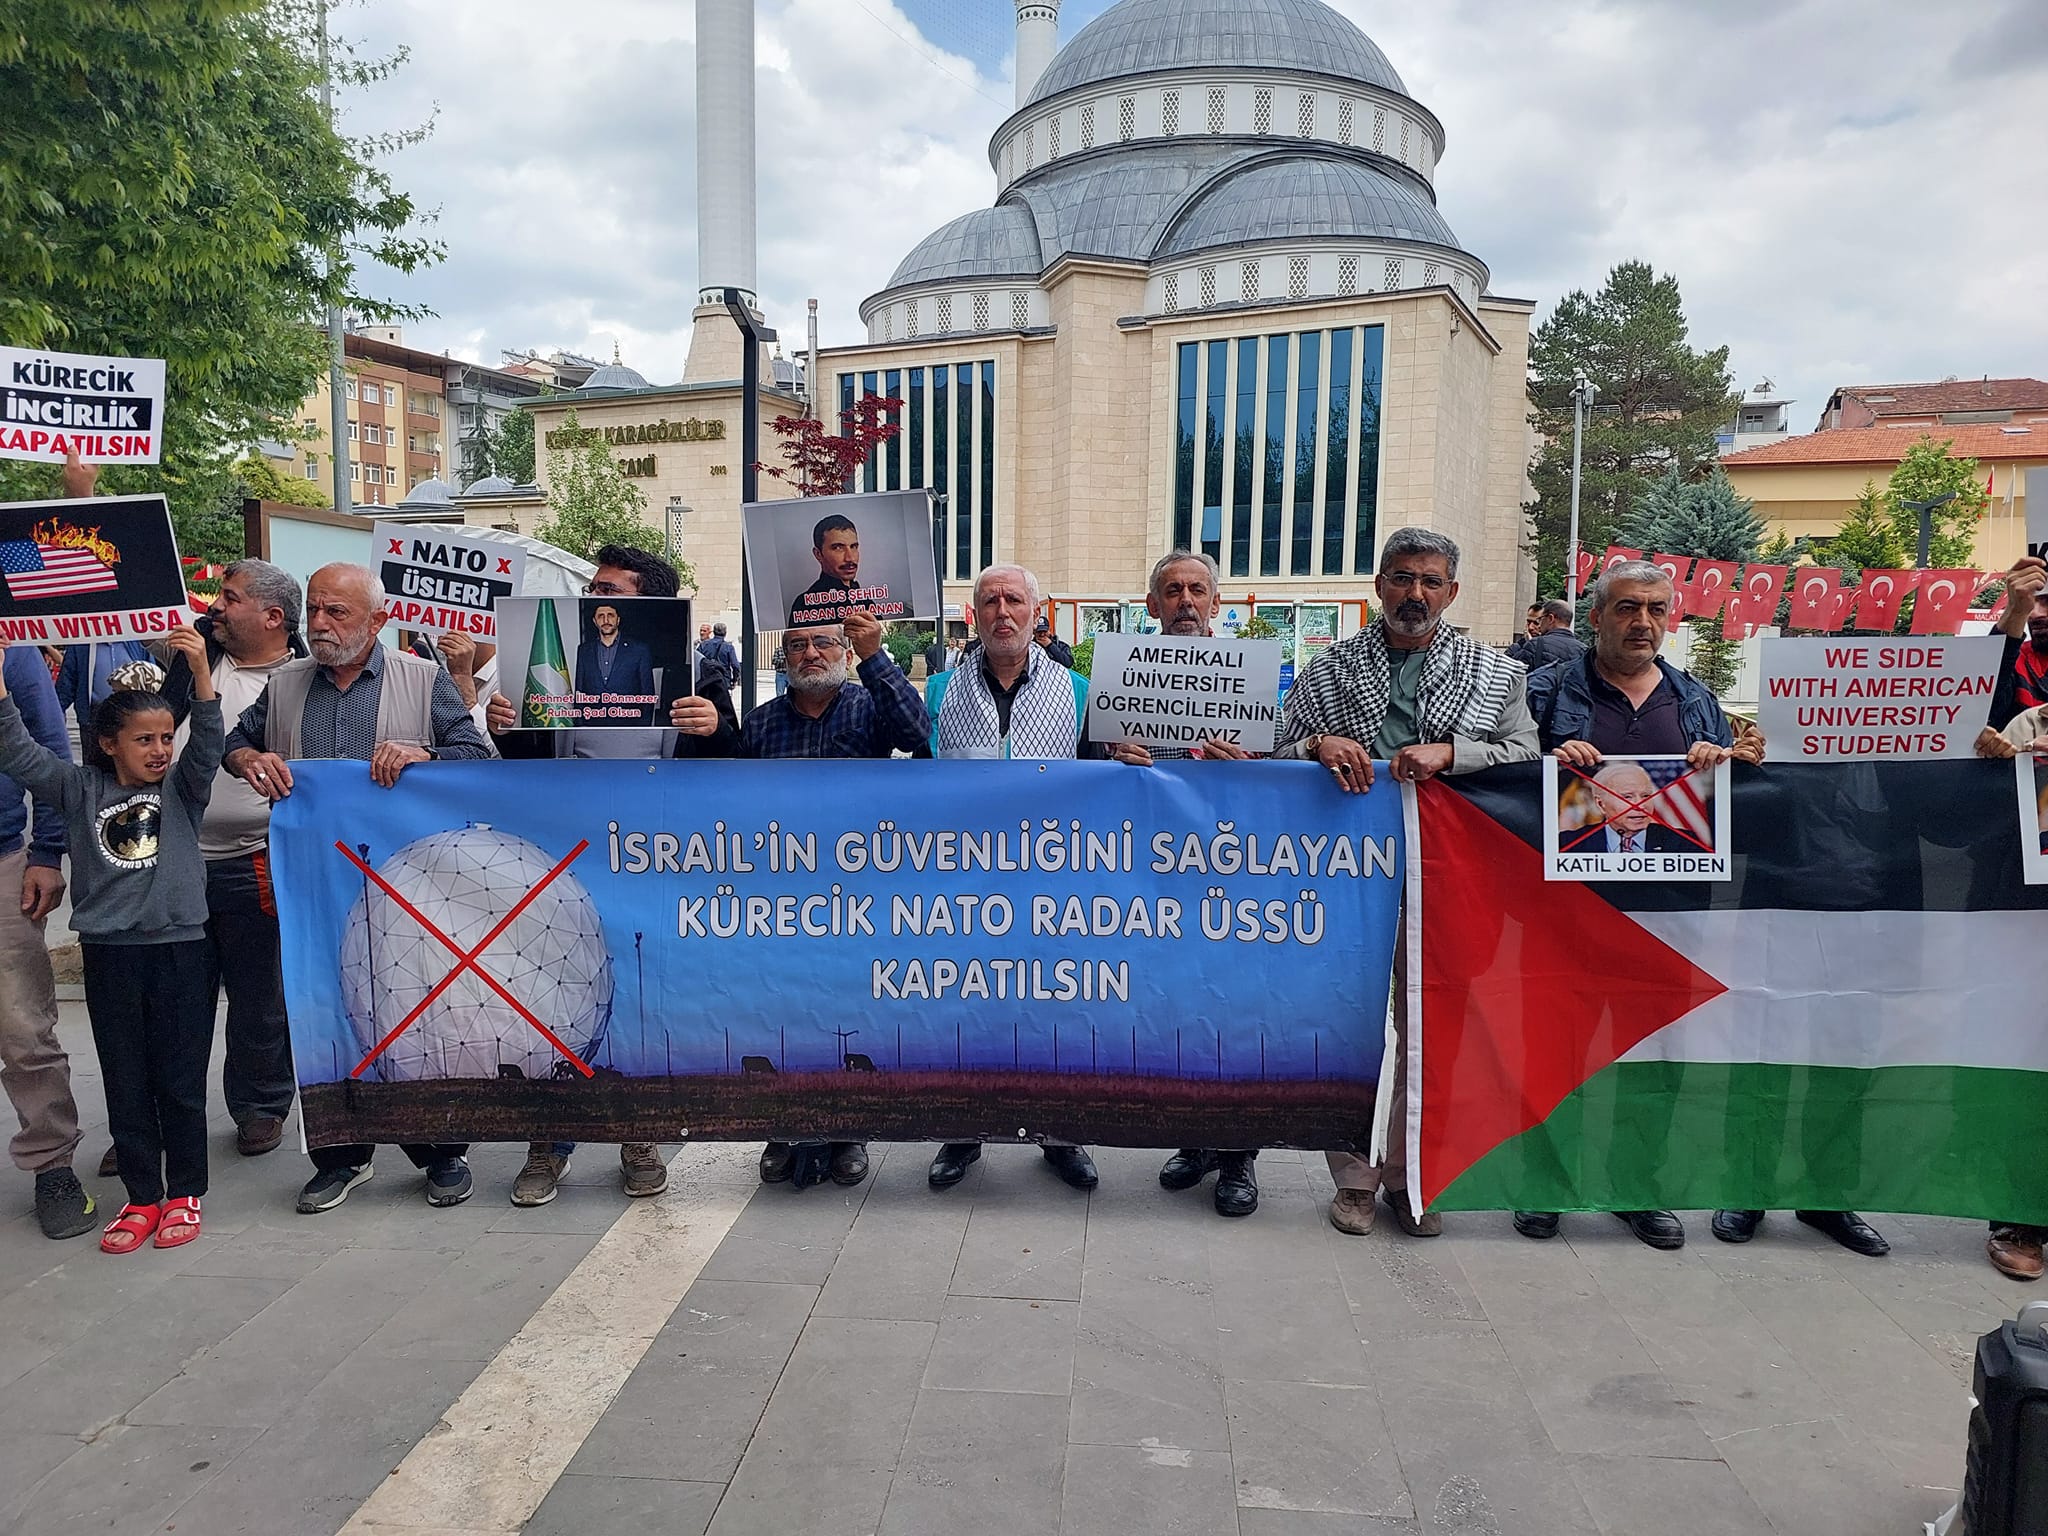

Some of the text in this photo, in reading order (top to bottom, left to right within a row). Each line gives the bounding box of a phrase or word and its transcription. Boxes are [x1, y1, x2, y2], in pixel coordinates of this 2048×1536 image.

[13, 358, 135, 393] KÜRECİK
[6, 391, 138, 428] İNCİRLİK
[411, 539, 488, 573] NATO
[401, 567, 490, 608] ÜSLERİ
[803, 584, 889, 606] KUDÜS ŞEHİDİ
[0, 608, 184, 641] WN WITH USA
[384, 597, 496, 638] APATILSI
[792, 607, 836, 623] HASAN
[1127, 645, 1244, 669] AMERİKALI
[1824, 647, 1944, 669] WE SIDE
[1121, 667, 1246, 695] ÜNİVERSİTE
[1768, 674, 1995, 698] WITH AMERICAN
[530, 693, 574, 704] Mehmet
[601, 692, 659, 704] Dönmezer
[1096, 690, 1275, 722] ÖGRENCİLERİNİN
[547, 707, 581, 718] Ruhun
[583, 706, 607, 720] Şad
[607, 706, 642, 718] Olsun
[1797, 704, 1962, 727] UNIVERSITY
[1119, 720, 1242, 746] YANINDAYIZ
[1802, 733, 1947, 755] STUDENTS
[607, 819, 1398, 880] İSRAİL'İN GÜVENLİĞİNİ SAĞLAYAN
[1556, 854, 1725, 873] KATİL JOE BİDEN
[677, 883, 1326, 946] KÜRECİK NATO RADAR ÜSSÜ
[871, 958, 1130, 1003] KAPATILSIN
